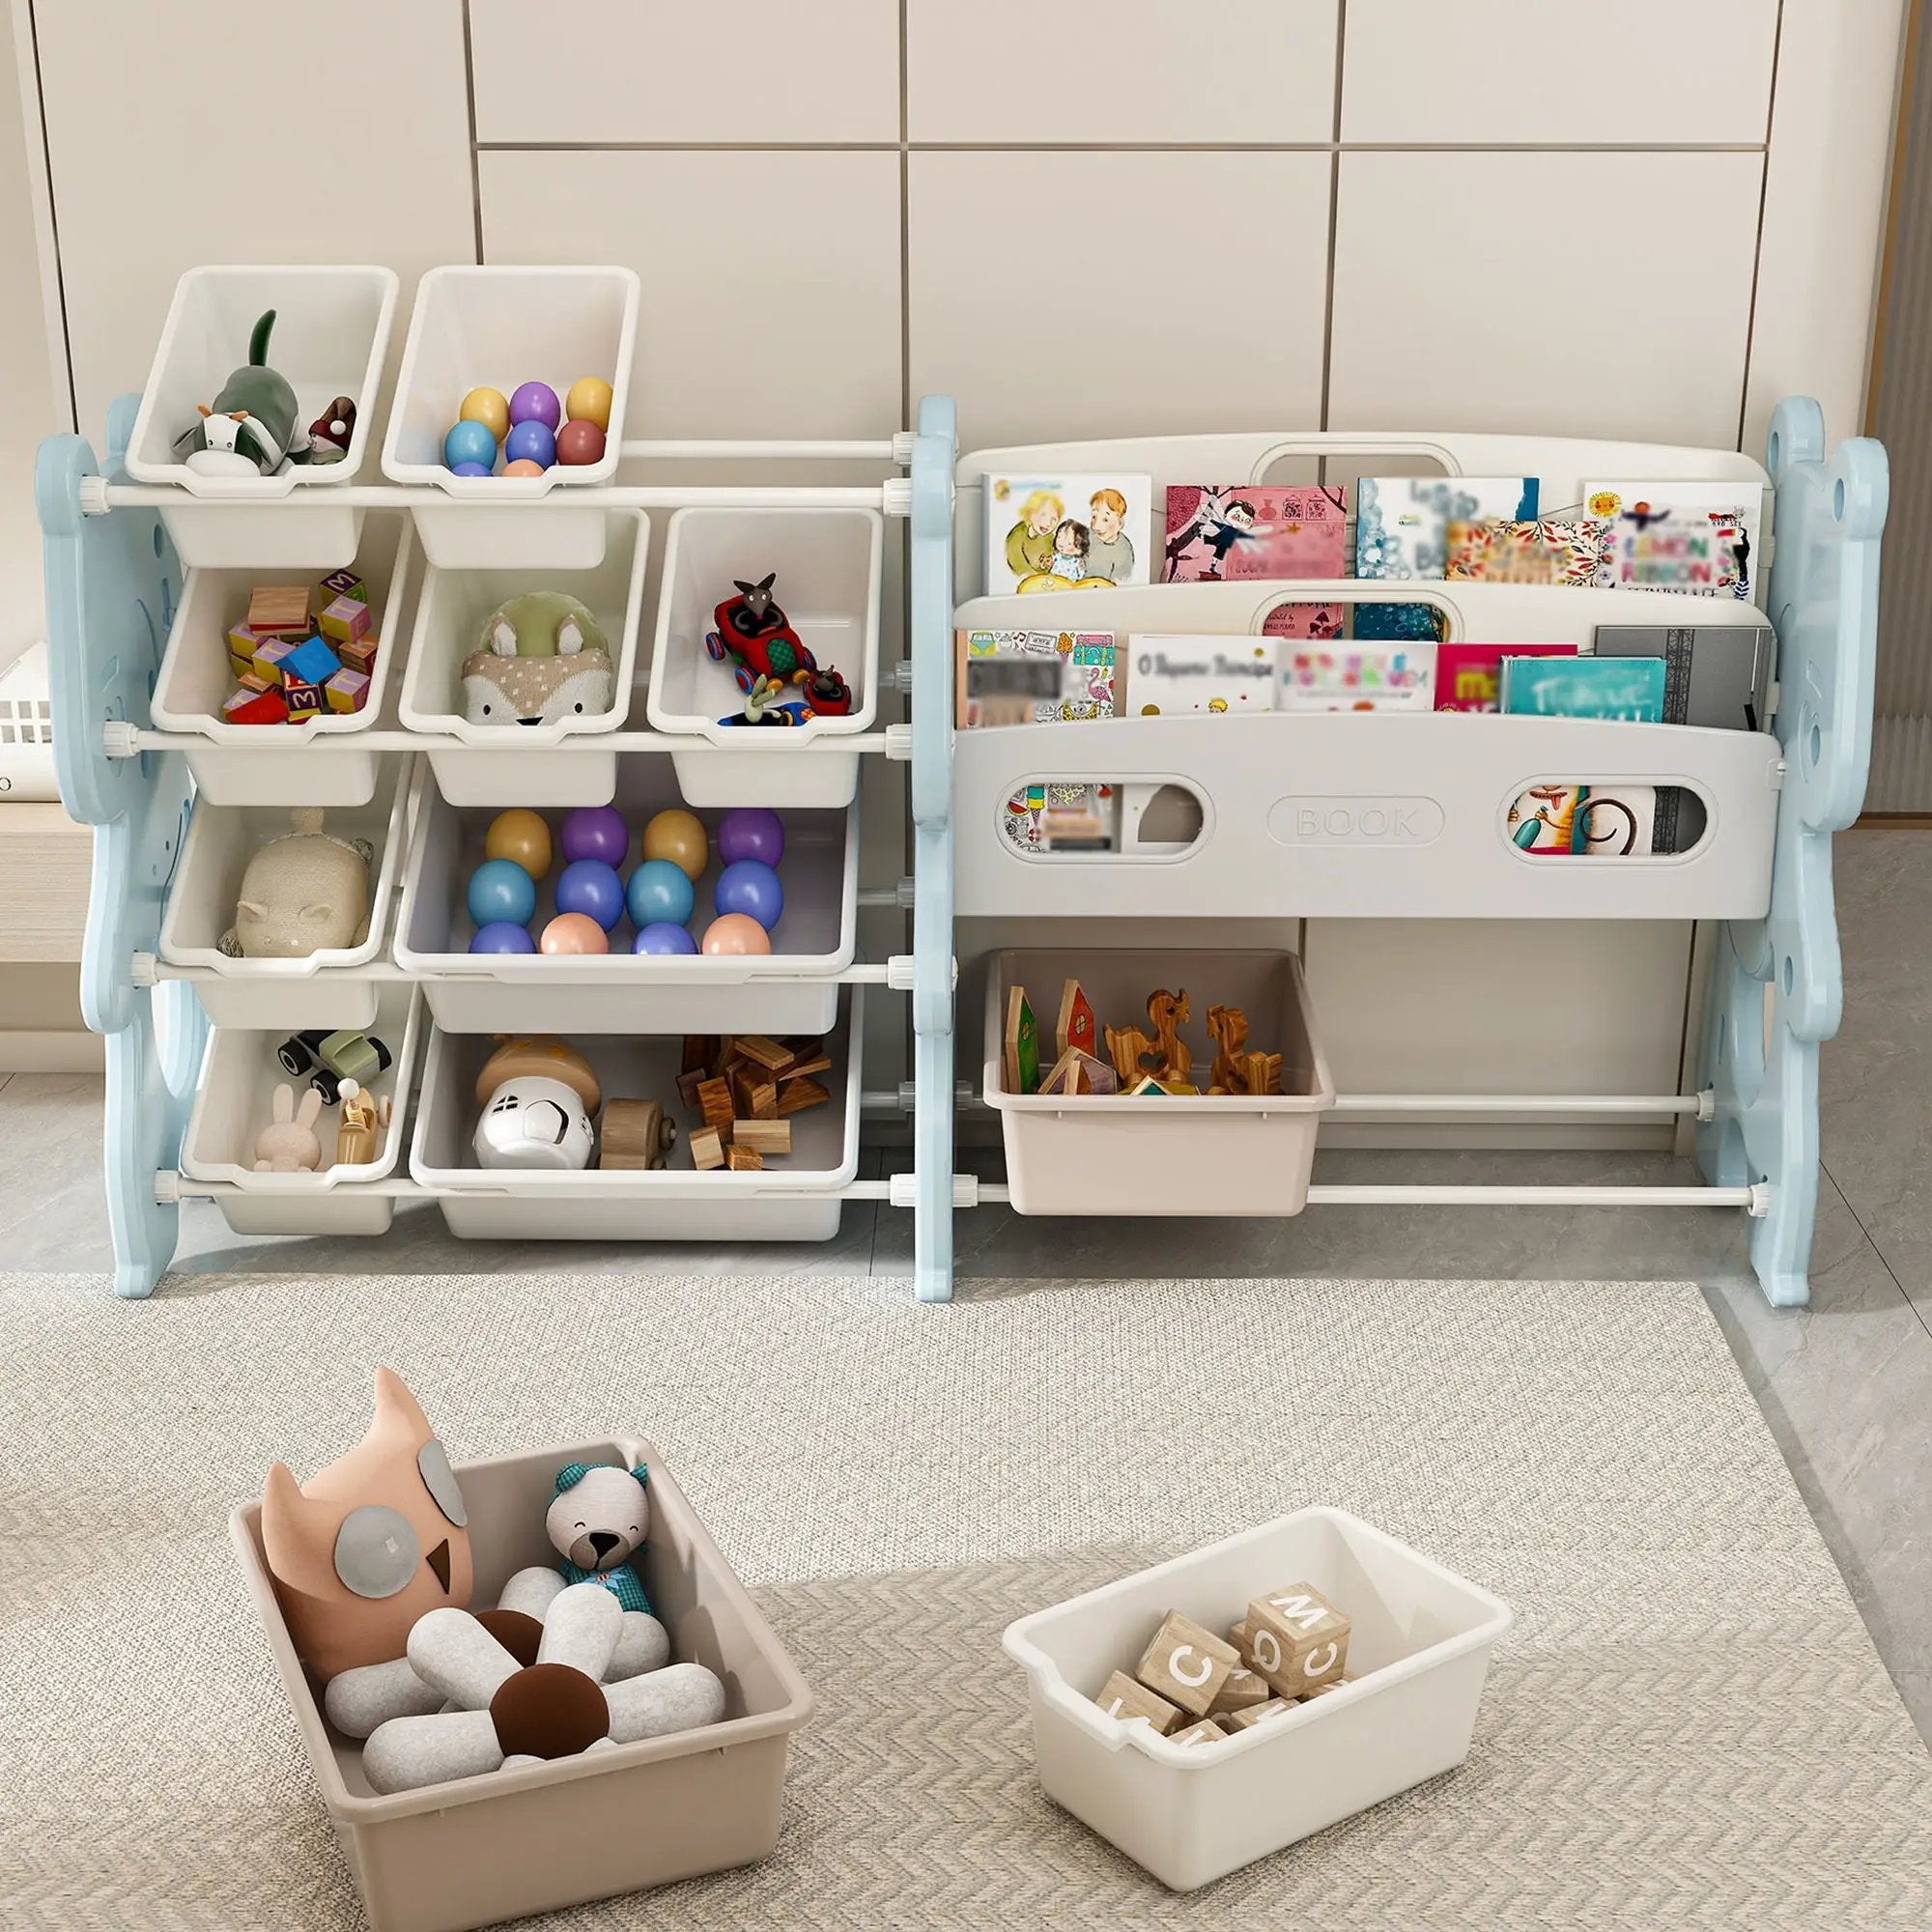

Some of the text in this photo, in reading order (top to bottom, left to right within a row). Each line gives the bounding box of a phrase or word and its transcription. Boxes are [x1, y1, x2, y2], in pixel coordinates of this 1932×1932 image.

[327, 573, 356, 591] M
[329, 600, 356, 614] T
[333, 671, 361, 687] T
[293, 691, 317, 709] M
[1296, 808, 1418, 837] BOOK
[1269, 1594, 1329, 1630] M
[1168, 1644, 1213, 1688] C
[1251, 1630, 1281, 1673] Q
[1303, 1642, 1338, 1677] C
